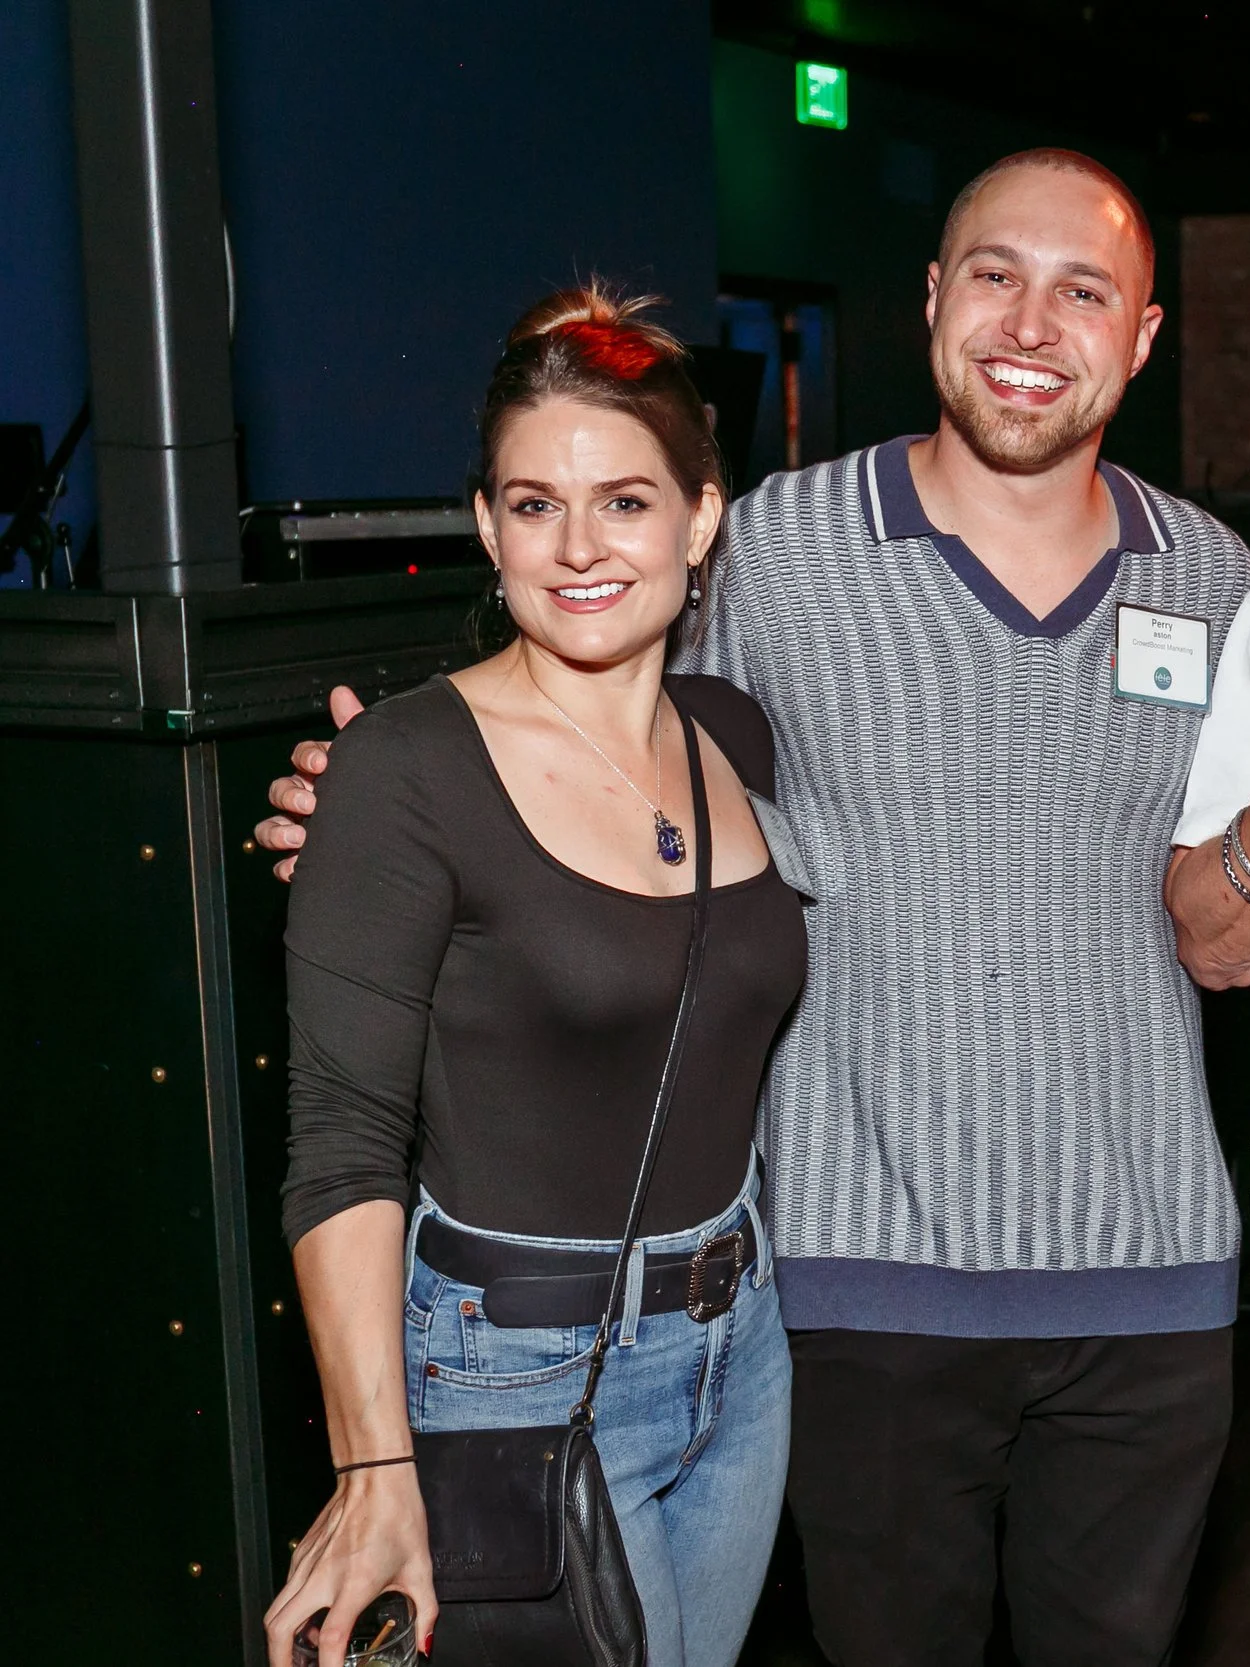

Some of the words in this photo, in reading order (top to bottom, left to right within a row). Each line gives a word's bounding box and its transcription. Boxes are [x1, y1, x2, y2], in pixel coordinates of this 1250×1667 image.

[1151, 618, 1173, 632] Perry
[1132, 639, 1166, 650] CrowdBoost
[1167, 644, 1193, 655] Marketing
